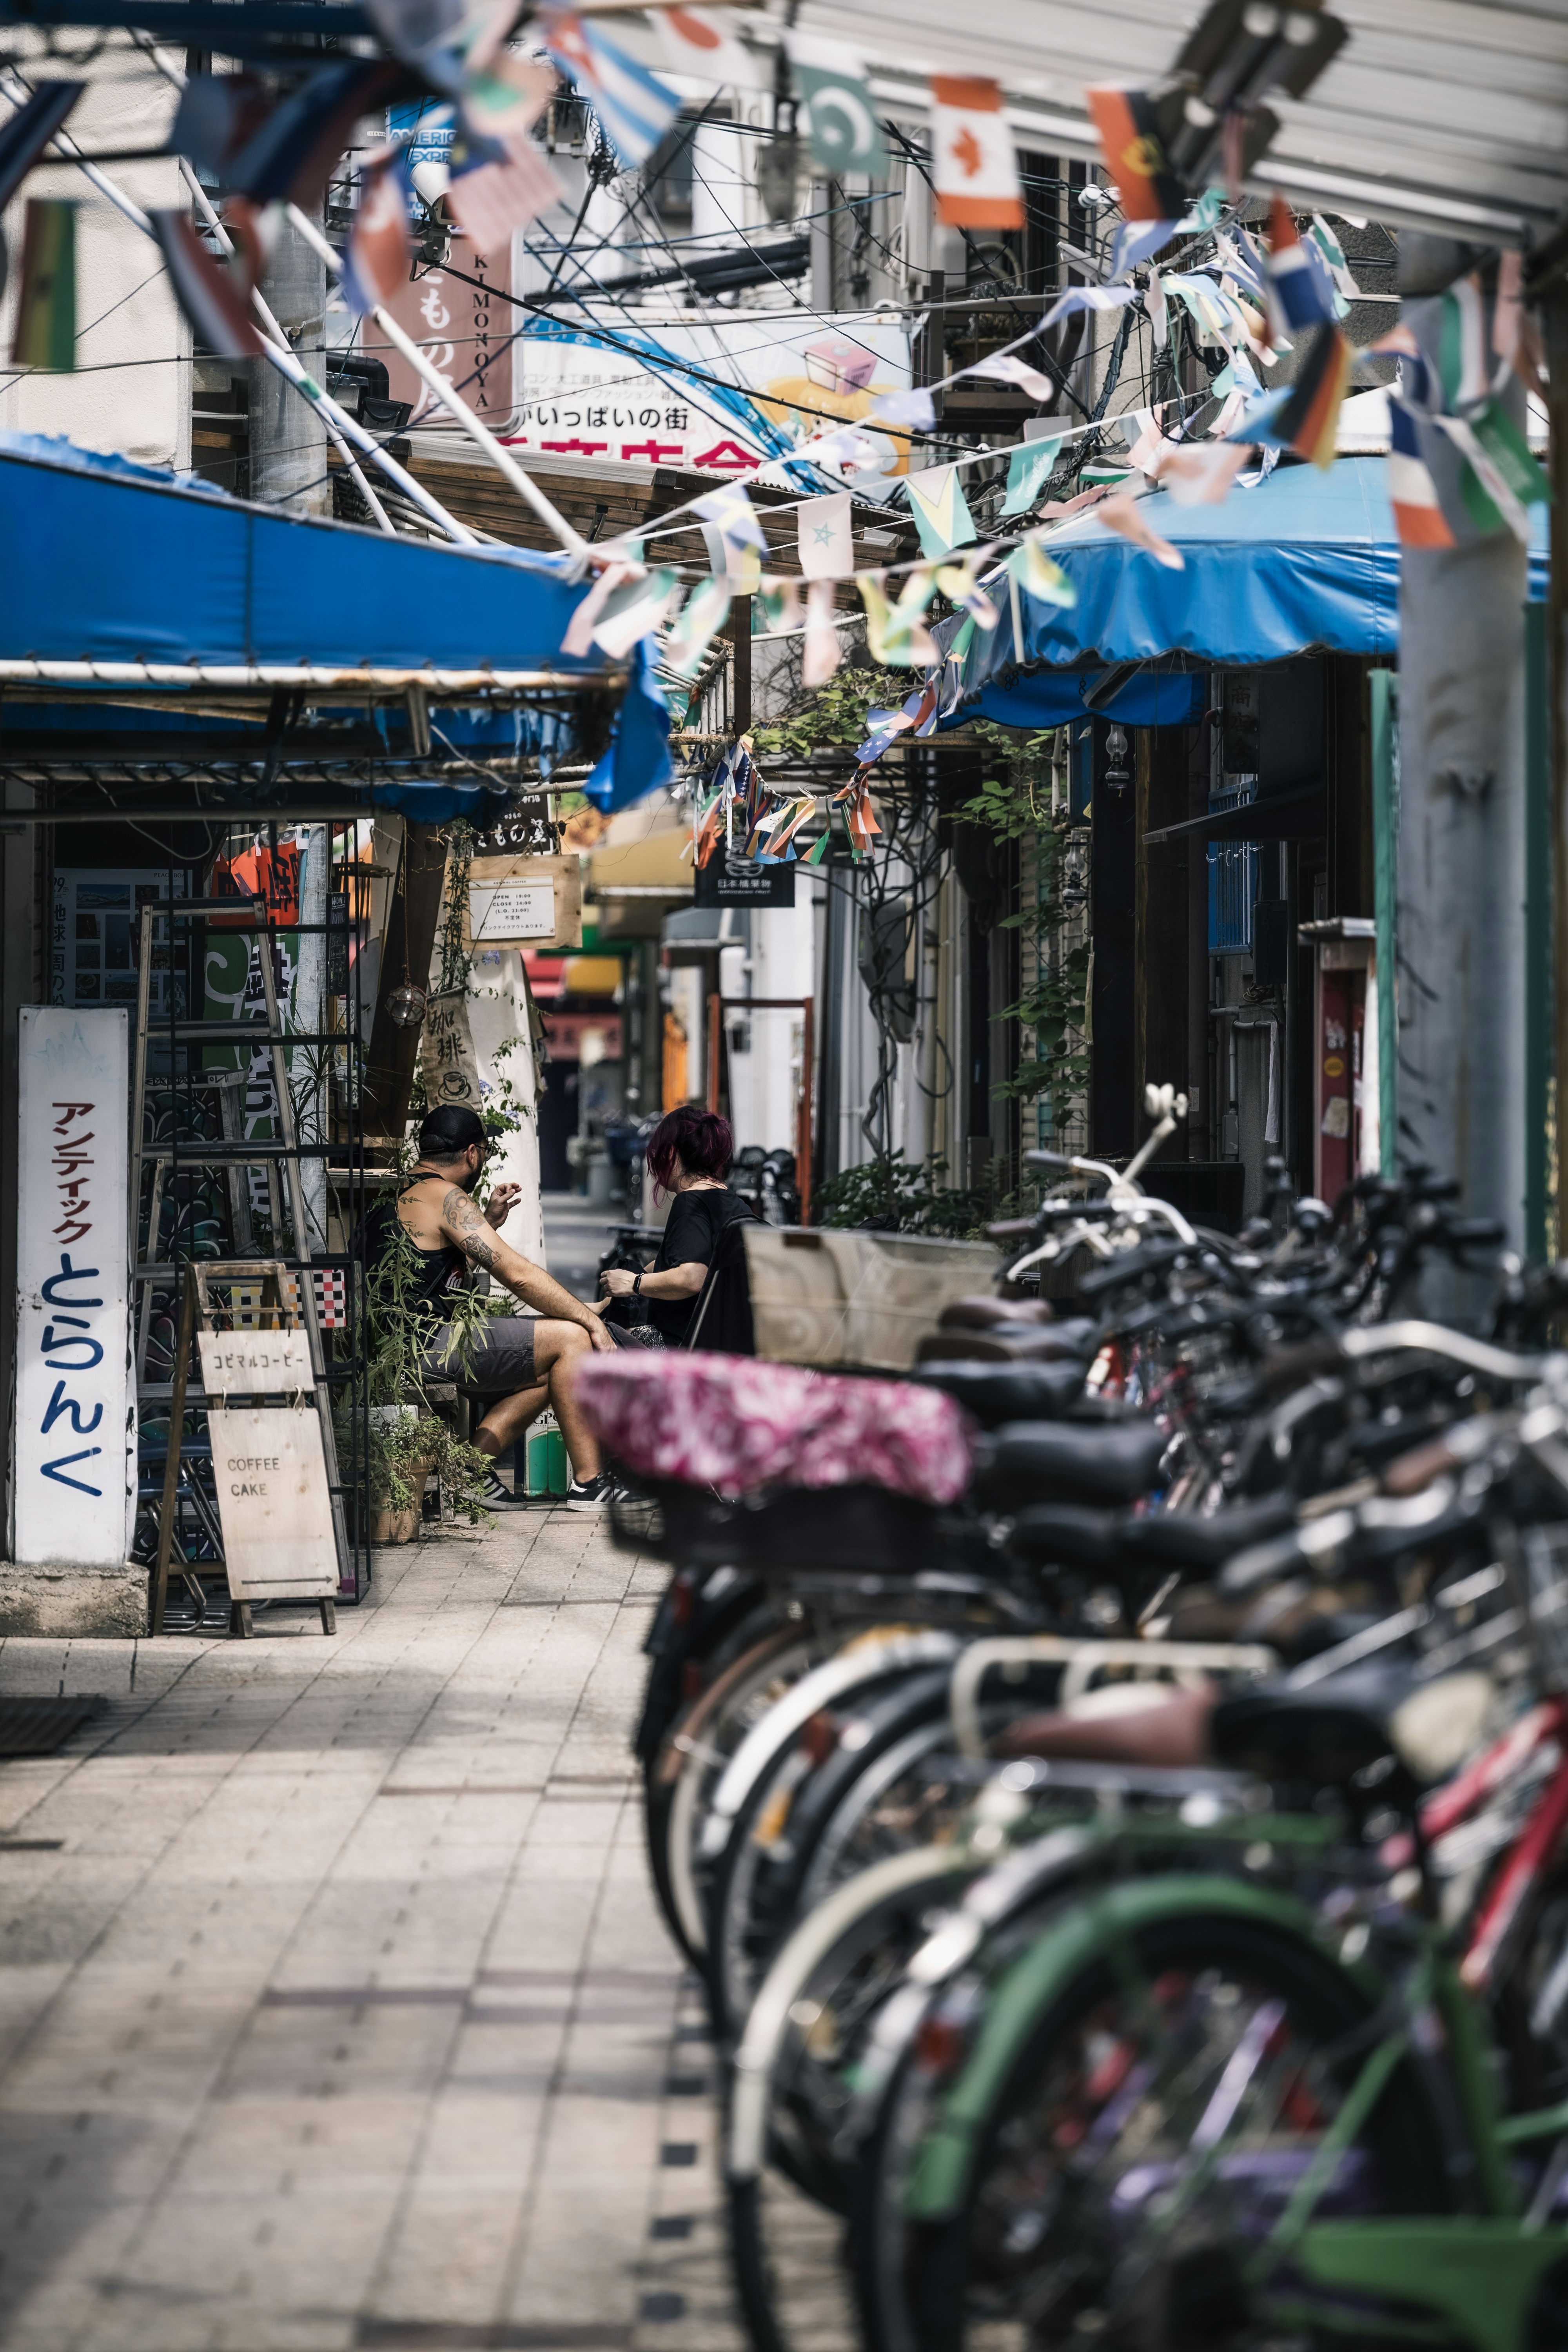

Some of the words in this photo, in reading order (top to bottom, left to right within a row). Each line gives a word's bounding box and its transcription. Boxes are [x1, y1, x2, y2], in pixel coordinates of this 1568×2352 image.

[390, 129, 457, 145] AMERIC
[411, 148, 452, 164] EXPR
[472, 254, 490, 407] KIMONOYA
[51, 1103, 96, 1244] アンティック
[40, 1253, 104, 1497] とらんく
[228, 1457, 280, 1471] COFFEE
[231, 1483, 268, 1497] CAKE
